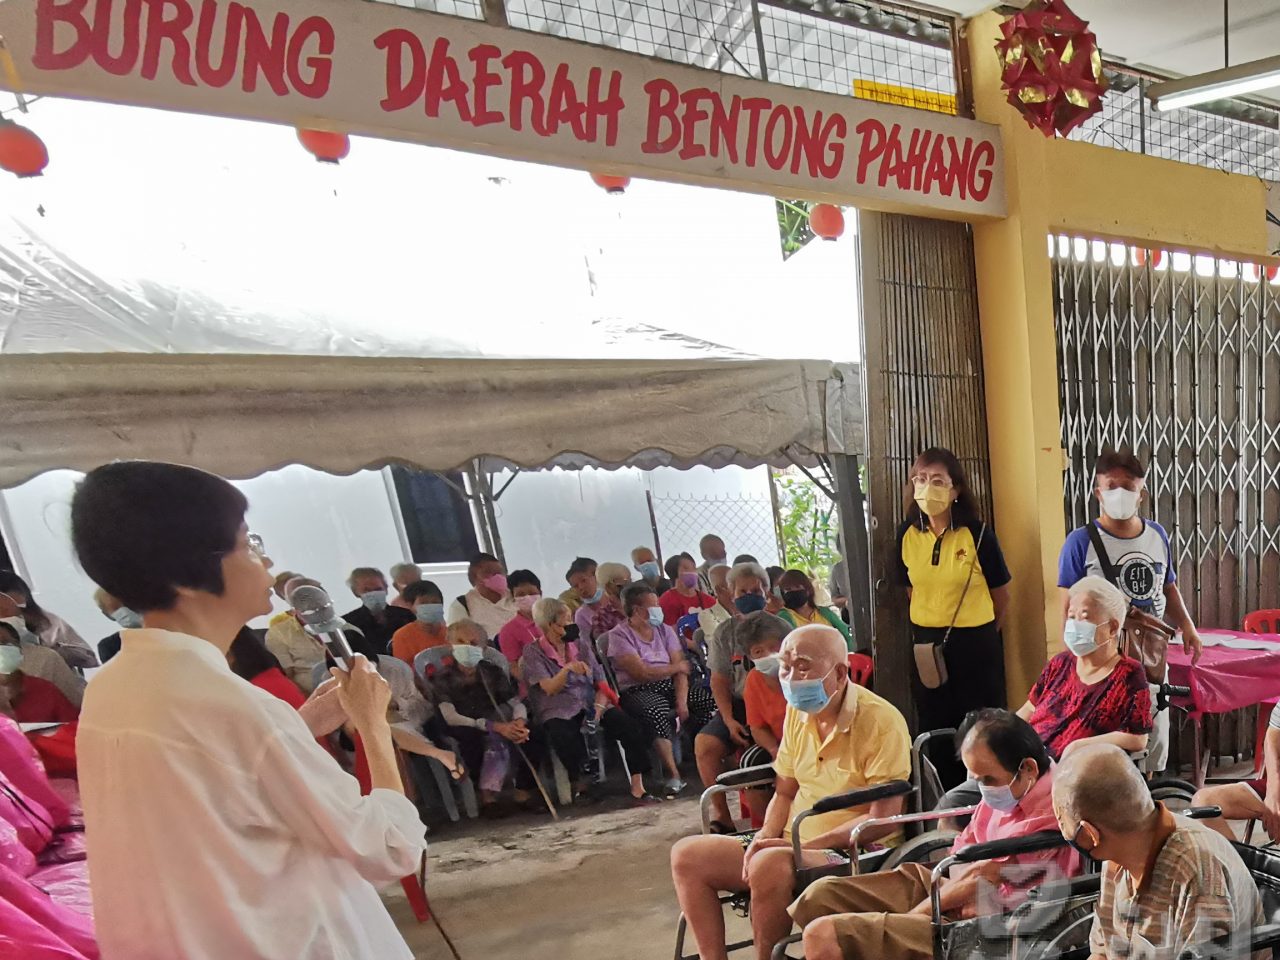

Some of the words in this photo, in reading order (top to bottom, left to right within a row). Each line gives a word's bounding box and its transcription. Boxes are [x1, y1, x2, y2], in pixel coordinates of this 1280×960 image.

[32, 0, 335, 99] BURUNG
[374, 28, 625, 147] DAERAH
[641, 78, 847, 180] BENTONG
[855, 117, 995, 203] PAHANG
